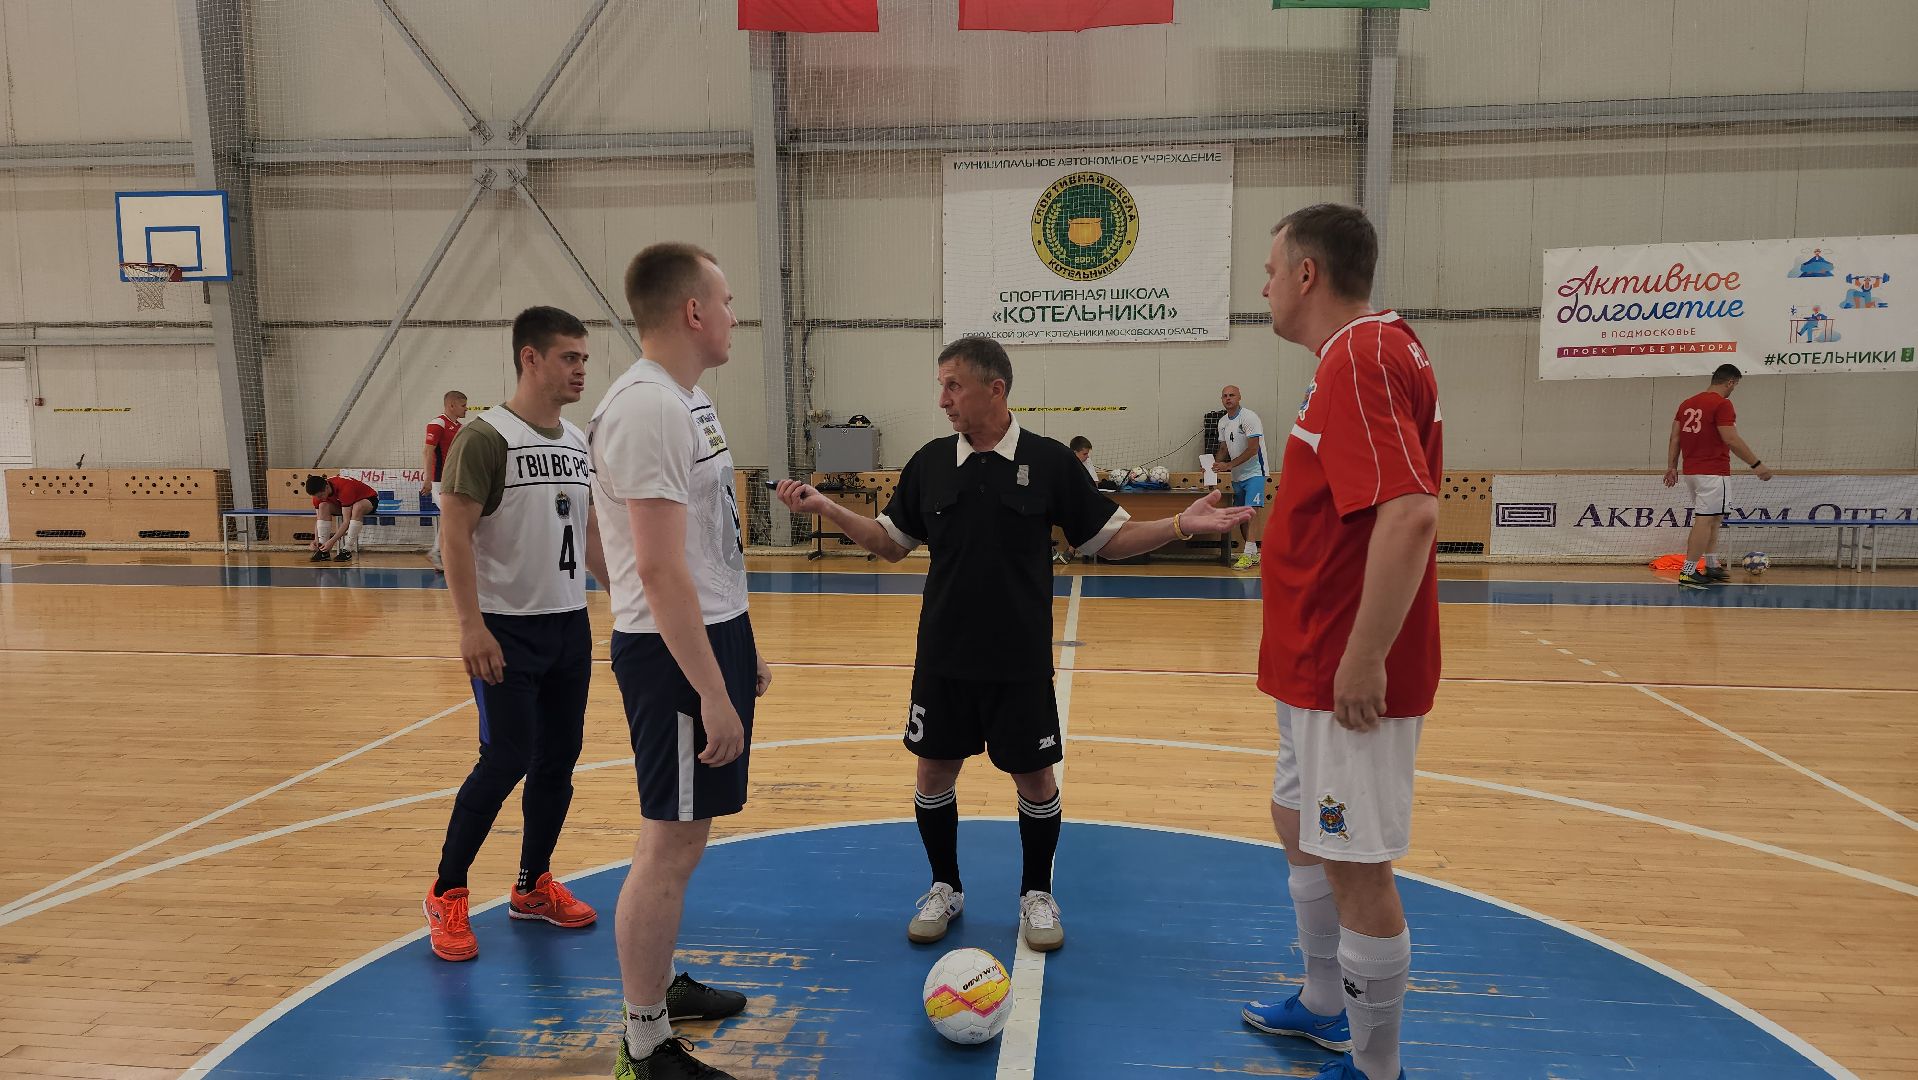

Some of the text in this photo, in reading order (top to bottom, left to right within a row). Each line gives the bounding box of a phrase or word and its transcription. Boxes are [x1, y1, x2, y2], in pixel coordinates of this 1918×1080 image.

[1057, 155, 1139, 167] АВТОНОМНОЕ
[1140, 152, 1222, 164] УЧРЕЖДЕНИЕ
[1035, 174, 1136, 225] СПОРТИВНАЯ ШКОЛА
[1048, 258, 1121, 280] КОТЕЛЬНИКИ
[1557, 262, 1742, 297] Активное
[999, 287, 1170, 303] СПОРТИВНАЯ ШКОЛА
[992, 303, 1178, 324] «КОТЕЛЬНИКИ»
[1556, 292, 1746, 324] долголетие
[1601, 327, 1696, 339] В ПОДМОСКОВЬЕ
[1562, 343, 1733, 356] ПРОЕКТ ГУБЕРНАТОРА
[1763, 350, 1896, 366] #КОТЕЛЬНИКИ
[1682, 407, 1703, 433] 23
[1229, 431, 1235, 443] 4
[516, 454, 550, 479] ГВЦ
[551, 454, 573, 477] ВС
[361, 470, 385, 482] МЫ
[1252, 493, 1261, 505] 4
[559, 525, 577, 580] 4
[1038, 734, 1057, 751] 2K
[629, 1009, 667, 1022] FILA
